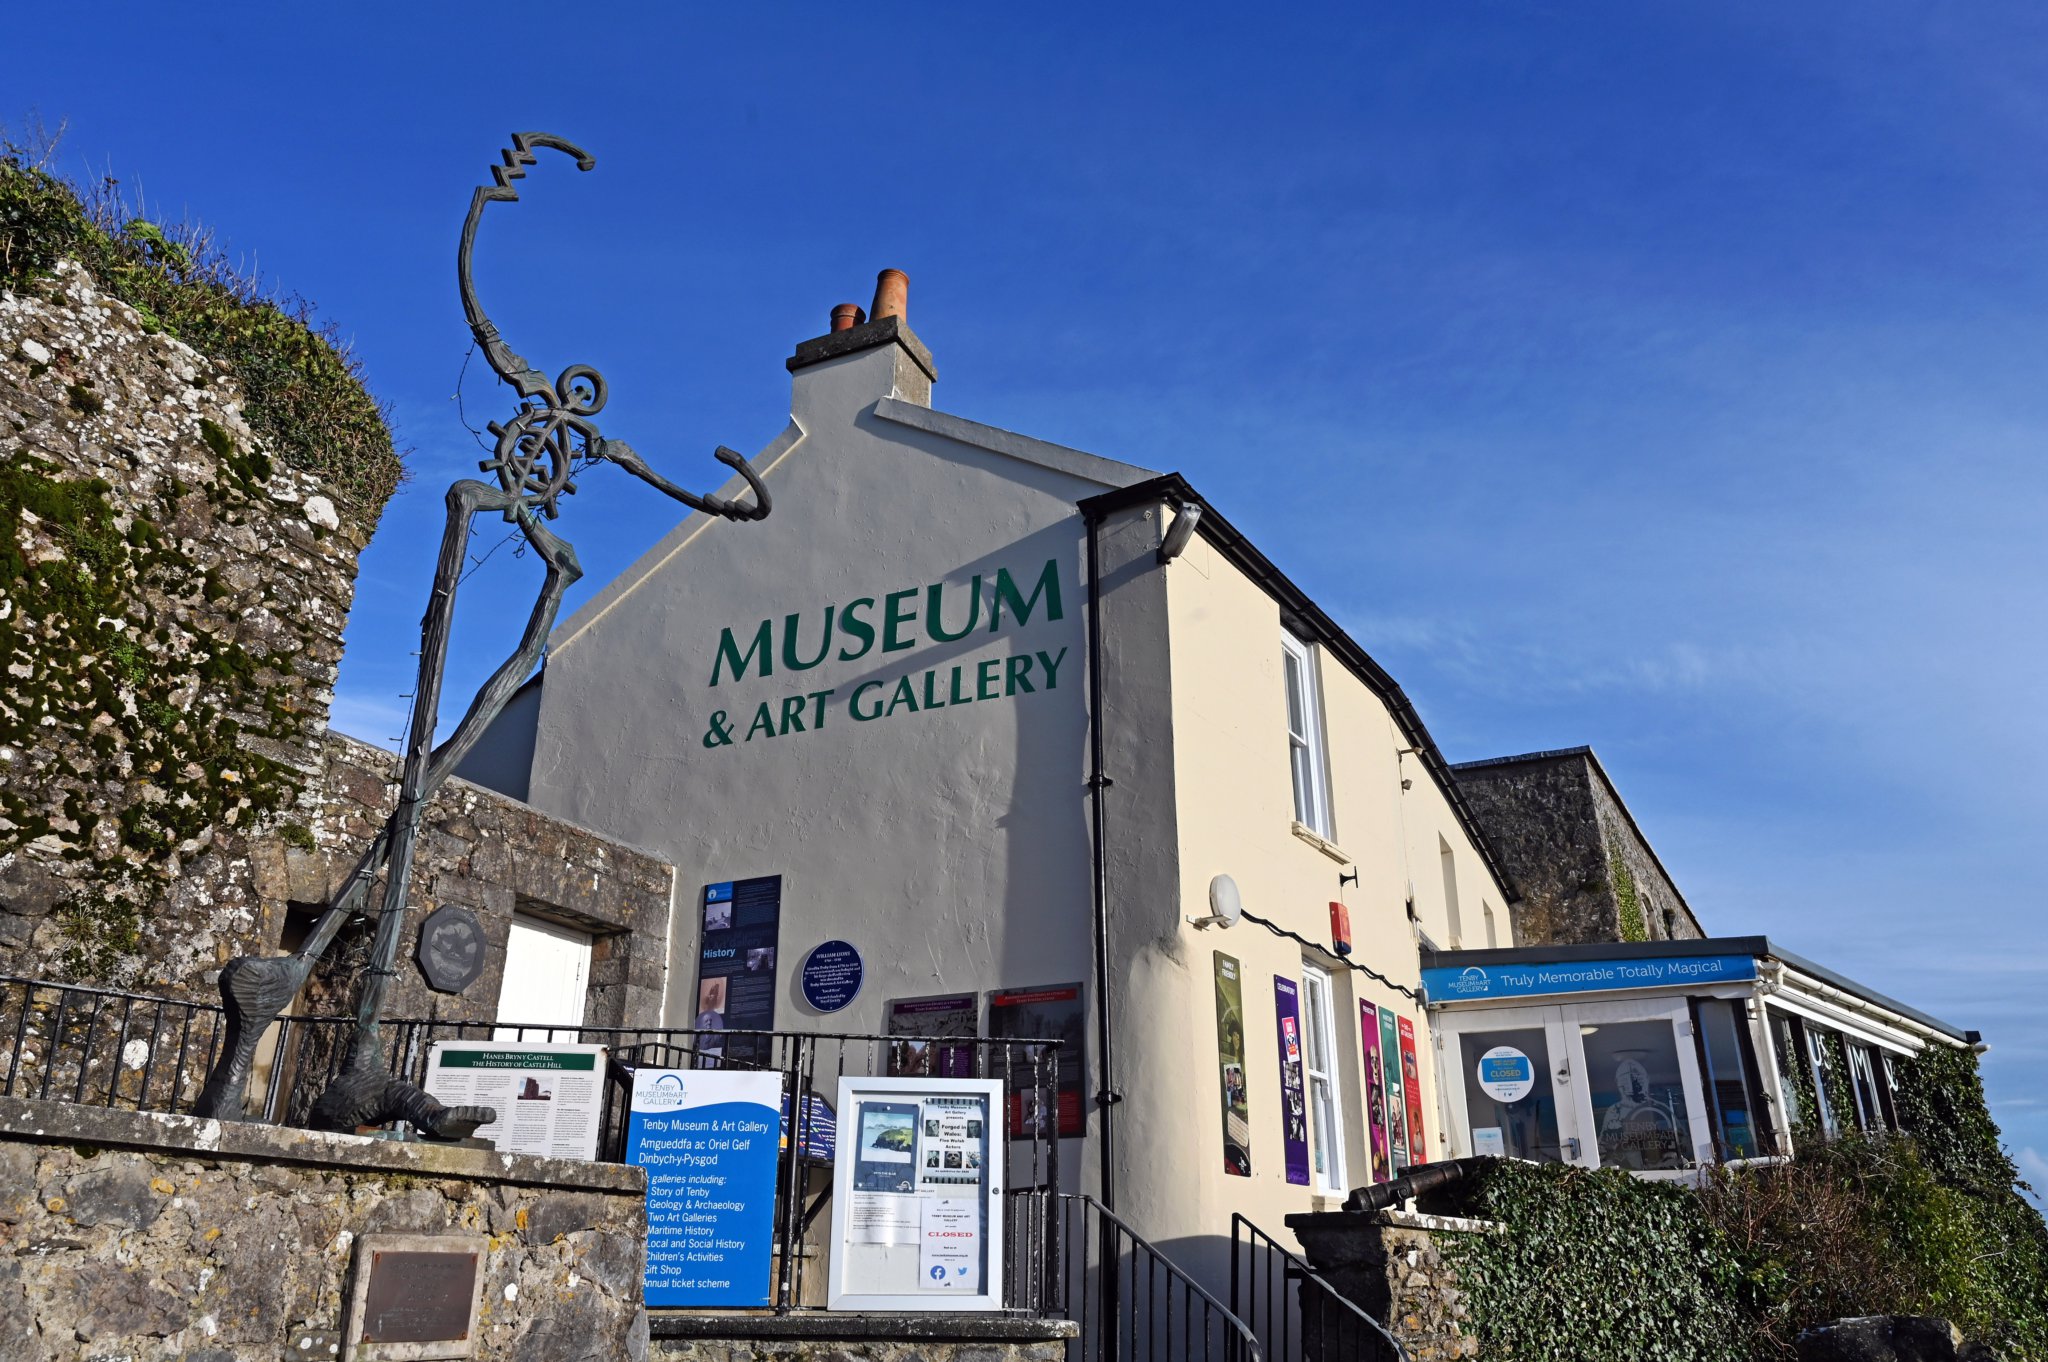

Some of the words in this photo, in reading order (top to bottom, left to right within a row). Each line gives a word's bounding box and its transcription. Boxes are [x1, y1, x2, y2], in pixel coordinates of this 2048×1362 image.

[709, 558, 1064, 687] MUSEUM
[702, 709, 735, 749] &
[745, 689, 835, 742] ART
[849, 646, 1069, 722] GALLERY
[703, 948, 736, 959] History
[1501, 973, 1535, 987] Truly
[1538, 969, 1614, 985] Memorable
[1617, 964, 1664, 980] Totally
[1668, 960, 1723, 976] Magical
[1456, 986, 1484, 994] GALLERY
[1490, 1069, 1521, 1078] CLOSED
[650, 1084, 675, 1092] TENBY
[642, 1118, 669, 1133] Tenby
[671, 1119, 709, 1131] Museum
[711, 1120, 719, 1131] &
[721, 1120, 736, 1132] Art
[737, 1120, 769, 1134] Gallery
[640, 1138, 692, 1151] Amgueddfa
[694, 1141, 706, 1150] ac
[708, 1138, 730, 1150] Oriel
[732, 1139, 751, 1150] Gelf
[638, 1152, 718, 1167] Dinbych-y-Pysgod
[651, 1174, 686, 1185] galleries
[688, 1174, 727, 1186] including:
[650, 1186, 673, 1197] Story
[675, 1186, 684, 1196] of
[686, 1186, 710, 1198] Tenby
[649, 1199, 683, 1211] Geology
[685, 1199, 692, 1209] &
[694, 1200, 745, 1211] Archaeology
[648, 1212, 664, 1222] Two
[667, 1212, 680, 1222] Art
[682, 1212, 717, 1223] Galleries
[646, 1225, 682, 1235] Maritime
[684, 1225, 715, 1237] History
[646, 1239, 669, 1248] Local
[670, 1239, 686, 1248] and
[688, 1238, 714, 1248] Social
[715, 1239, 746, 1251] History
[686, 1251, 724, 1262] Activities
[643, 1264, 658, 1275] Gift
[660, 1264, 682, 1276] Shop
[642, 1277, 670, 1288] Annual
[671, 1278, 695, 1288] ticket
[697, 1278, 731, 1288] scheme
